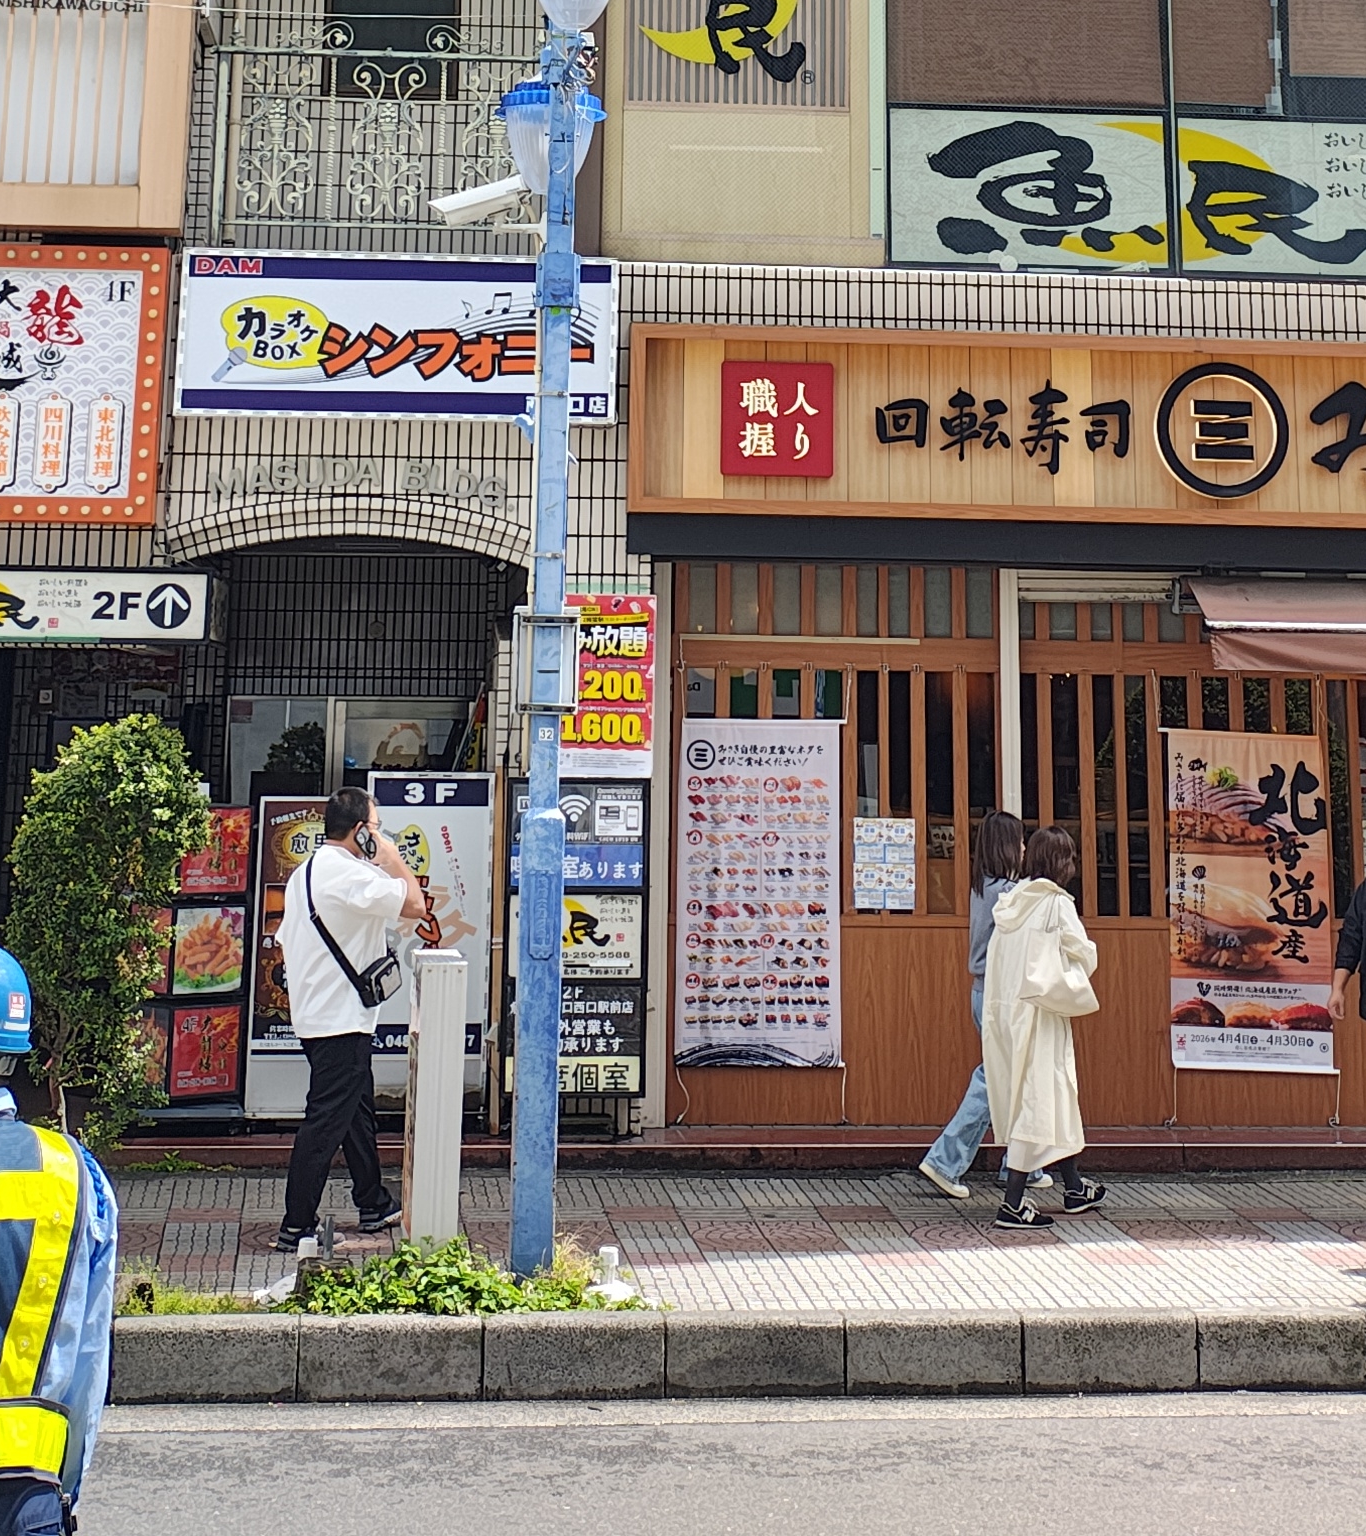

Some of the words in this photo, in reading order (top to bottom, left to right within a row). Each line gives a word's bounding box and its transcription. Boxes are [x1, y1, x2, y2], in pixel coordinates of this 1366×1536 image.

[194, 257, 263, 275] DAM
[237, 307, 319, 344] カラオケ
[253, 339, 303, 361] BOX
[740, 379, 819, 416] 職人
[40, 408, 63, 477] 四川料理
[92, 408, 115, 477] 東北料理
[739, 421, 812, 461] 握り
[875, 377, 1134, 477] 回転寿司
[207, 458, 380, 502] MASUDA
[92, 591, 142, 620] 2F
[540, 729, 553, 740] 32
[404, 783, 457, 804] 3F
[441, 826, 452, 853] open
[1249, 762, 1328, 963] 北海道産
[563, 986, 585, 999] 2F
